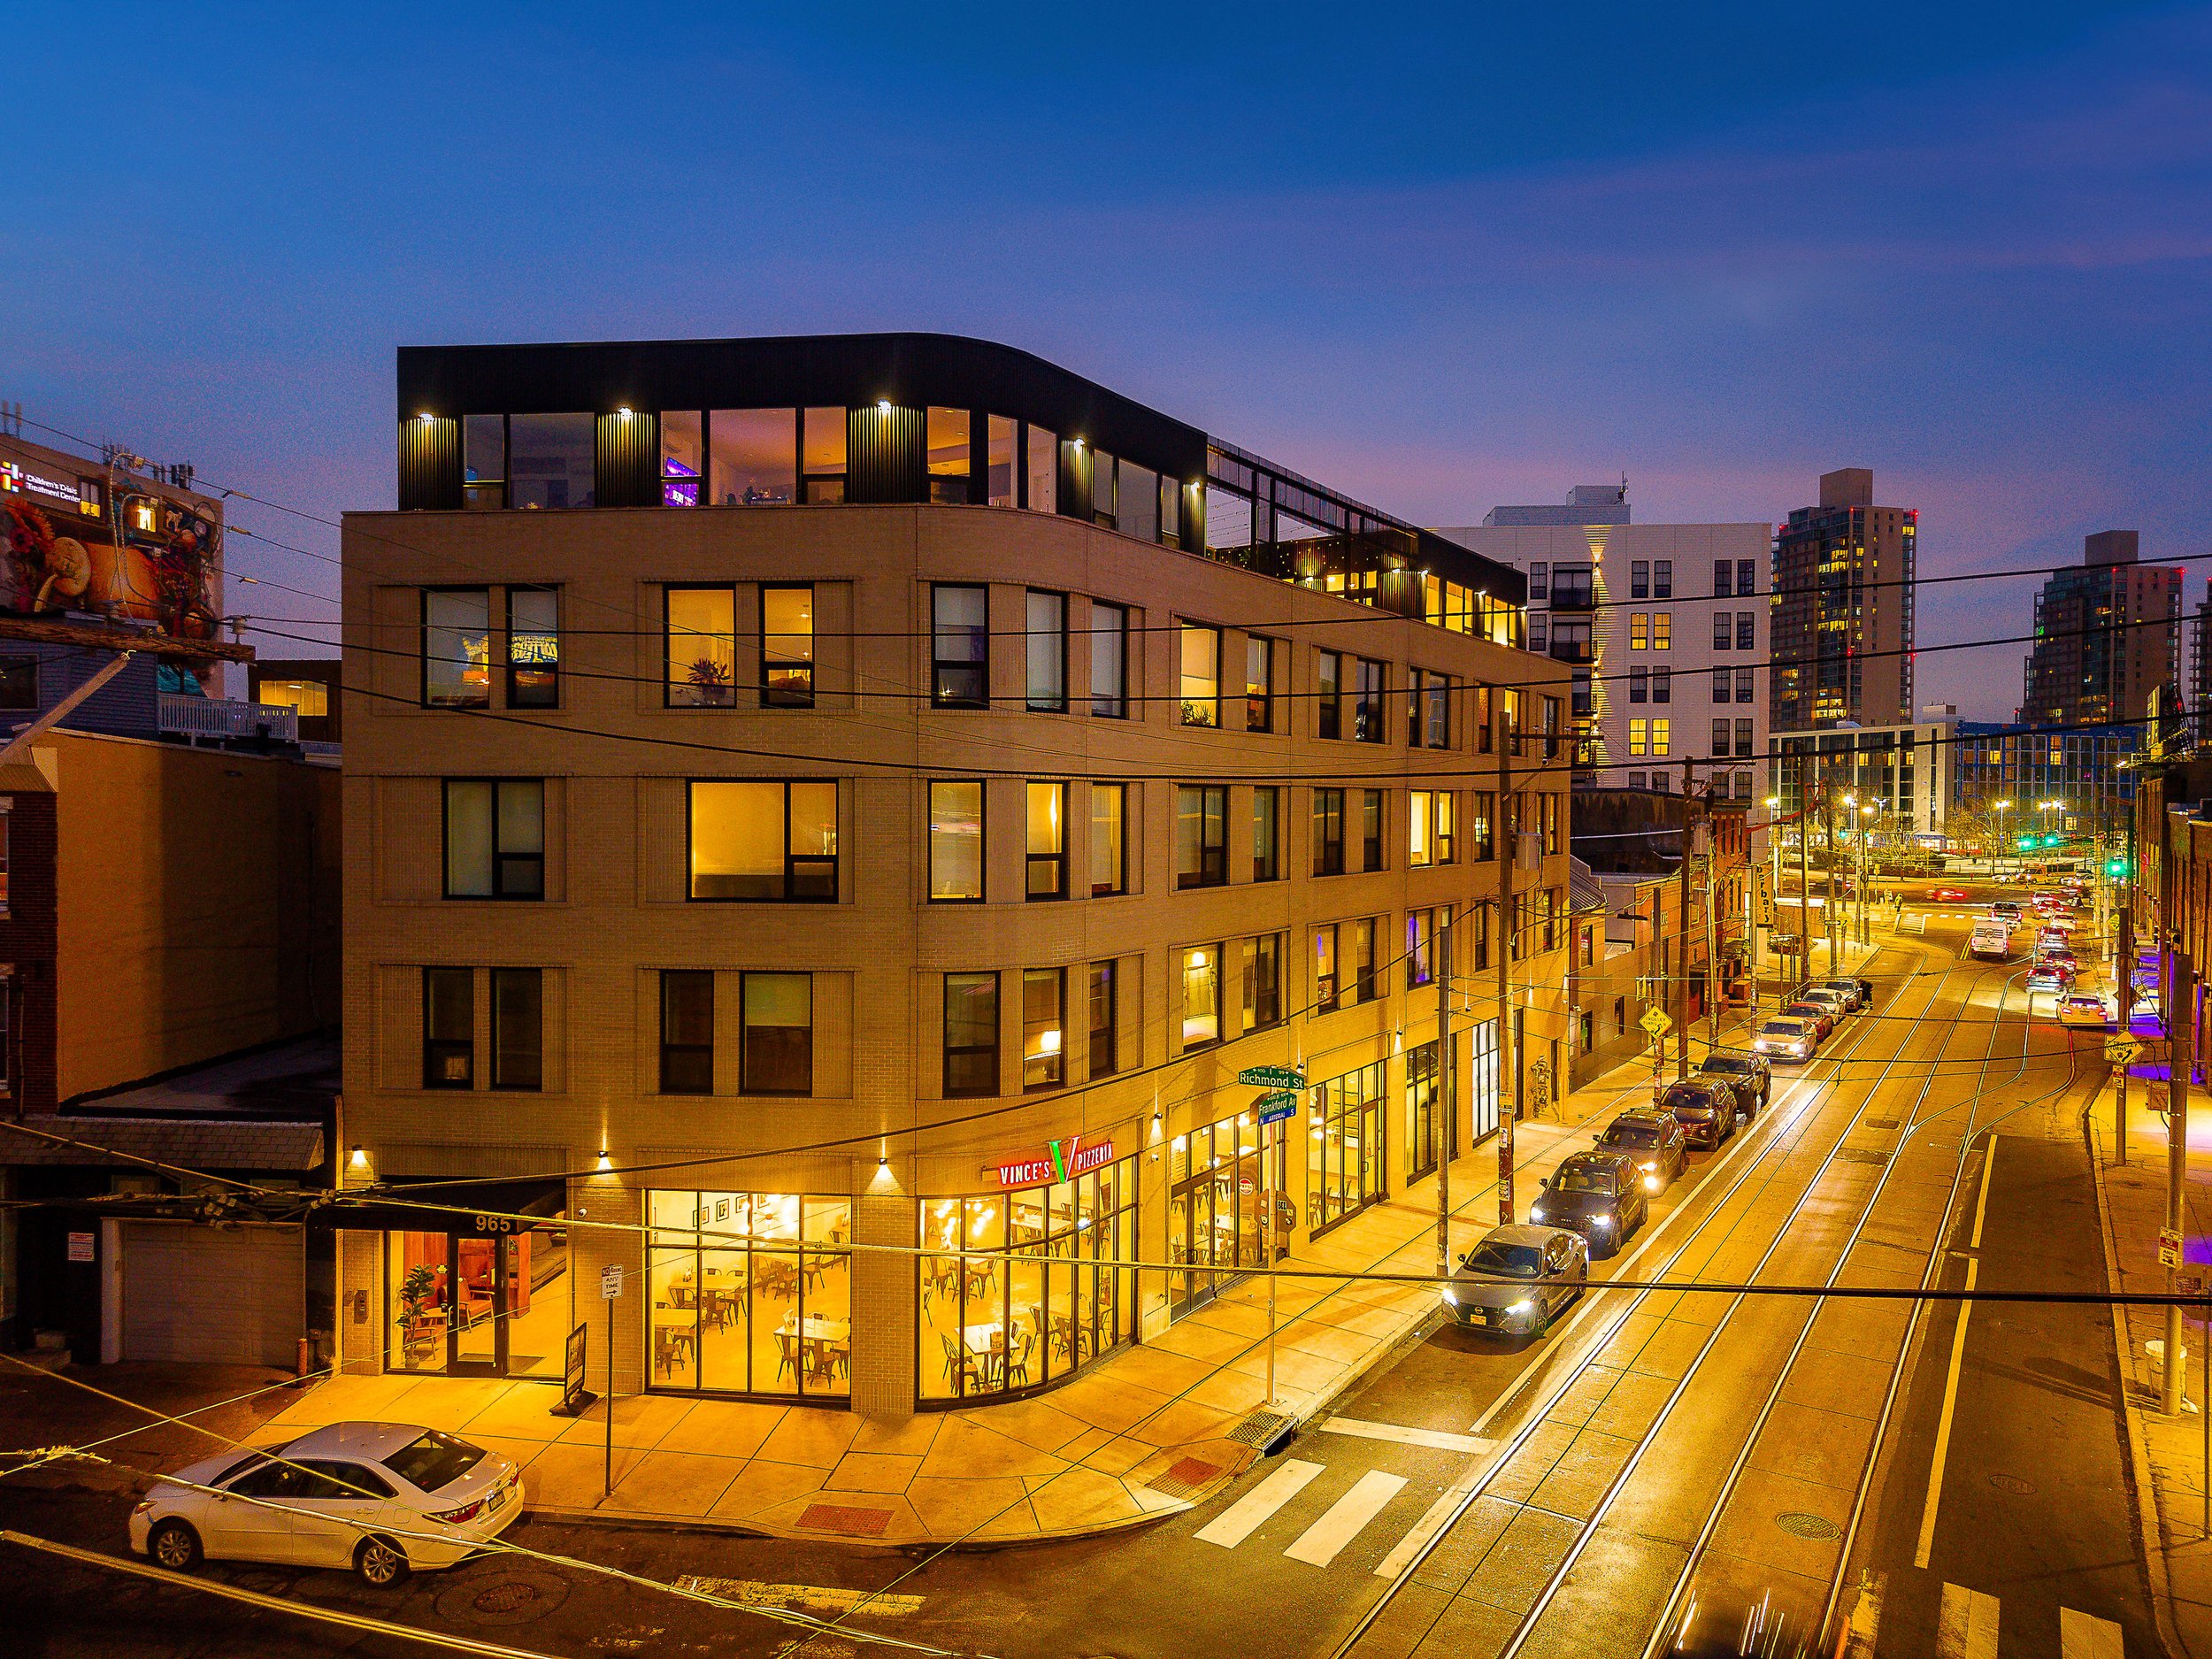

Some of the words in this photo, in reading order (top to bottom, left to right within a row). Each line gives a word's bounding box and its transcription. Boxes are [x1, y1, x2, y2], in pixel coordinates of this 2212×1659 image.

[26, 474, 59, 489] Children's
[60, 483, 78, 495] Crisis
[26, 482, 59, 497] Treatment
[60, 490, 81, 503] Center
[1756, 864, 1769, 922] barbary
[1240, 1072, 1289, 1087] Richmond
[1293, 1078, 1303, 1088] St
[1259, 1098, 1287, 1115] Frankford
[1289, 1097, 1295, 1106] Av
[1259, 1117, 1264, 1125] N
[1000, 1161, 1050, 1185] VINCE'S
[1078, 1142, 1112, 1171] PIZZERIA
[476, 1215, 511, 1232] 965
